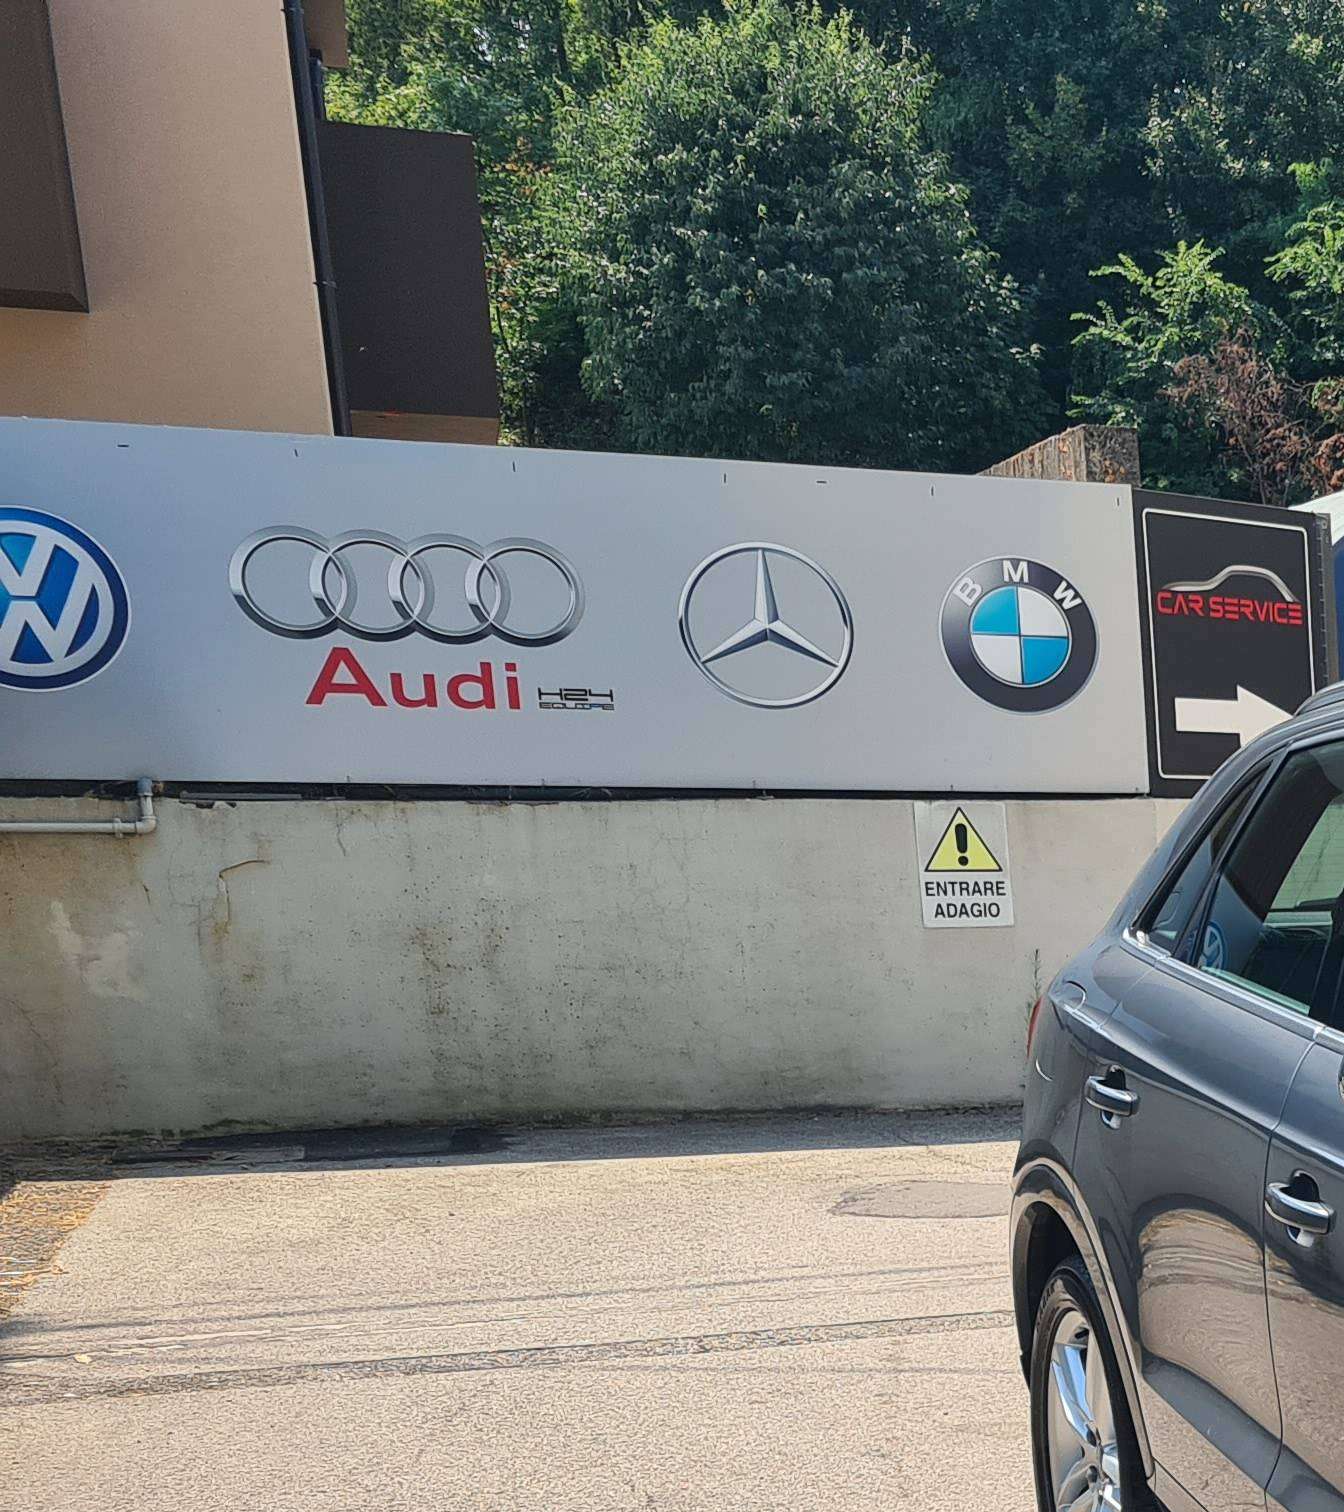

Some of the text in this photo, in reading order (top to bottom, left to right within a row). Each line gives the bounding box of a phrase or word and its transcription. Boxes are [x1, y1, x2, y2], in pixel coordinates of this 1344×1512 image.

[952, 559, 1083, 611] BMW
[1156, 591, 1303, 625] CAR SERVICE
[305, 646, 521, 710] Audi
[537, 687, 614, 702] H24
[924, 881, 1007, 897] ENTRARE
[934, 902, 1001, 918] ADAGIO
